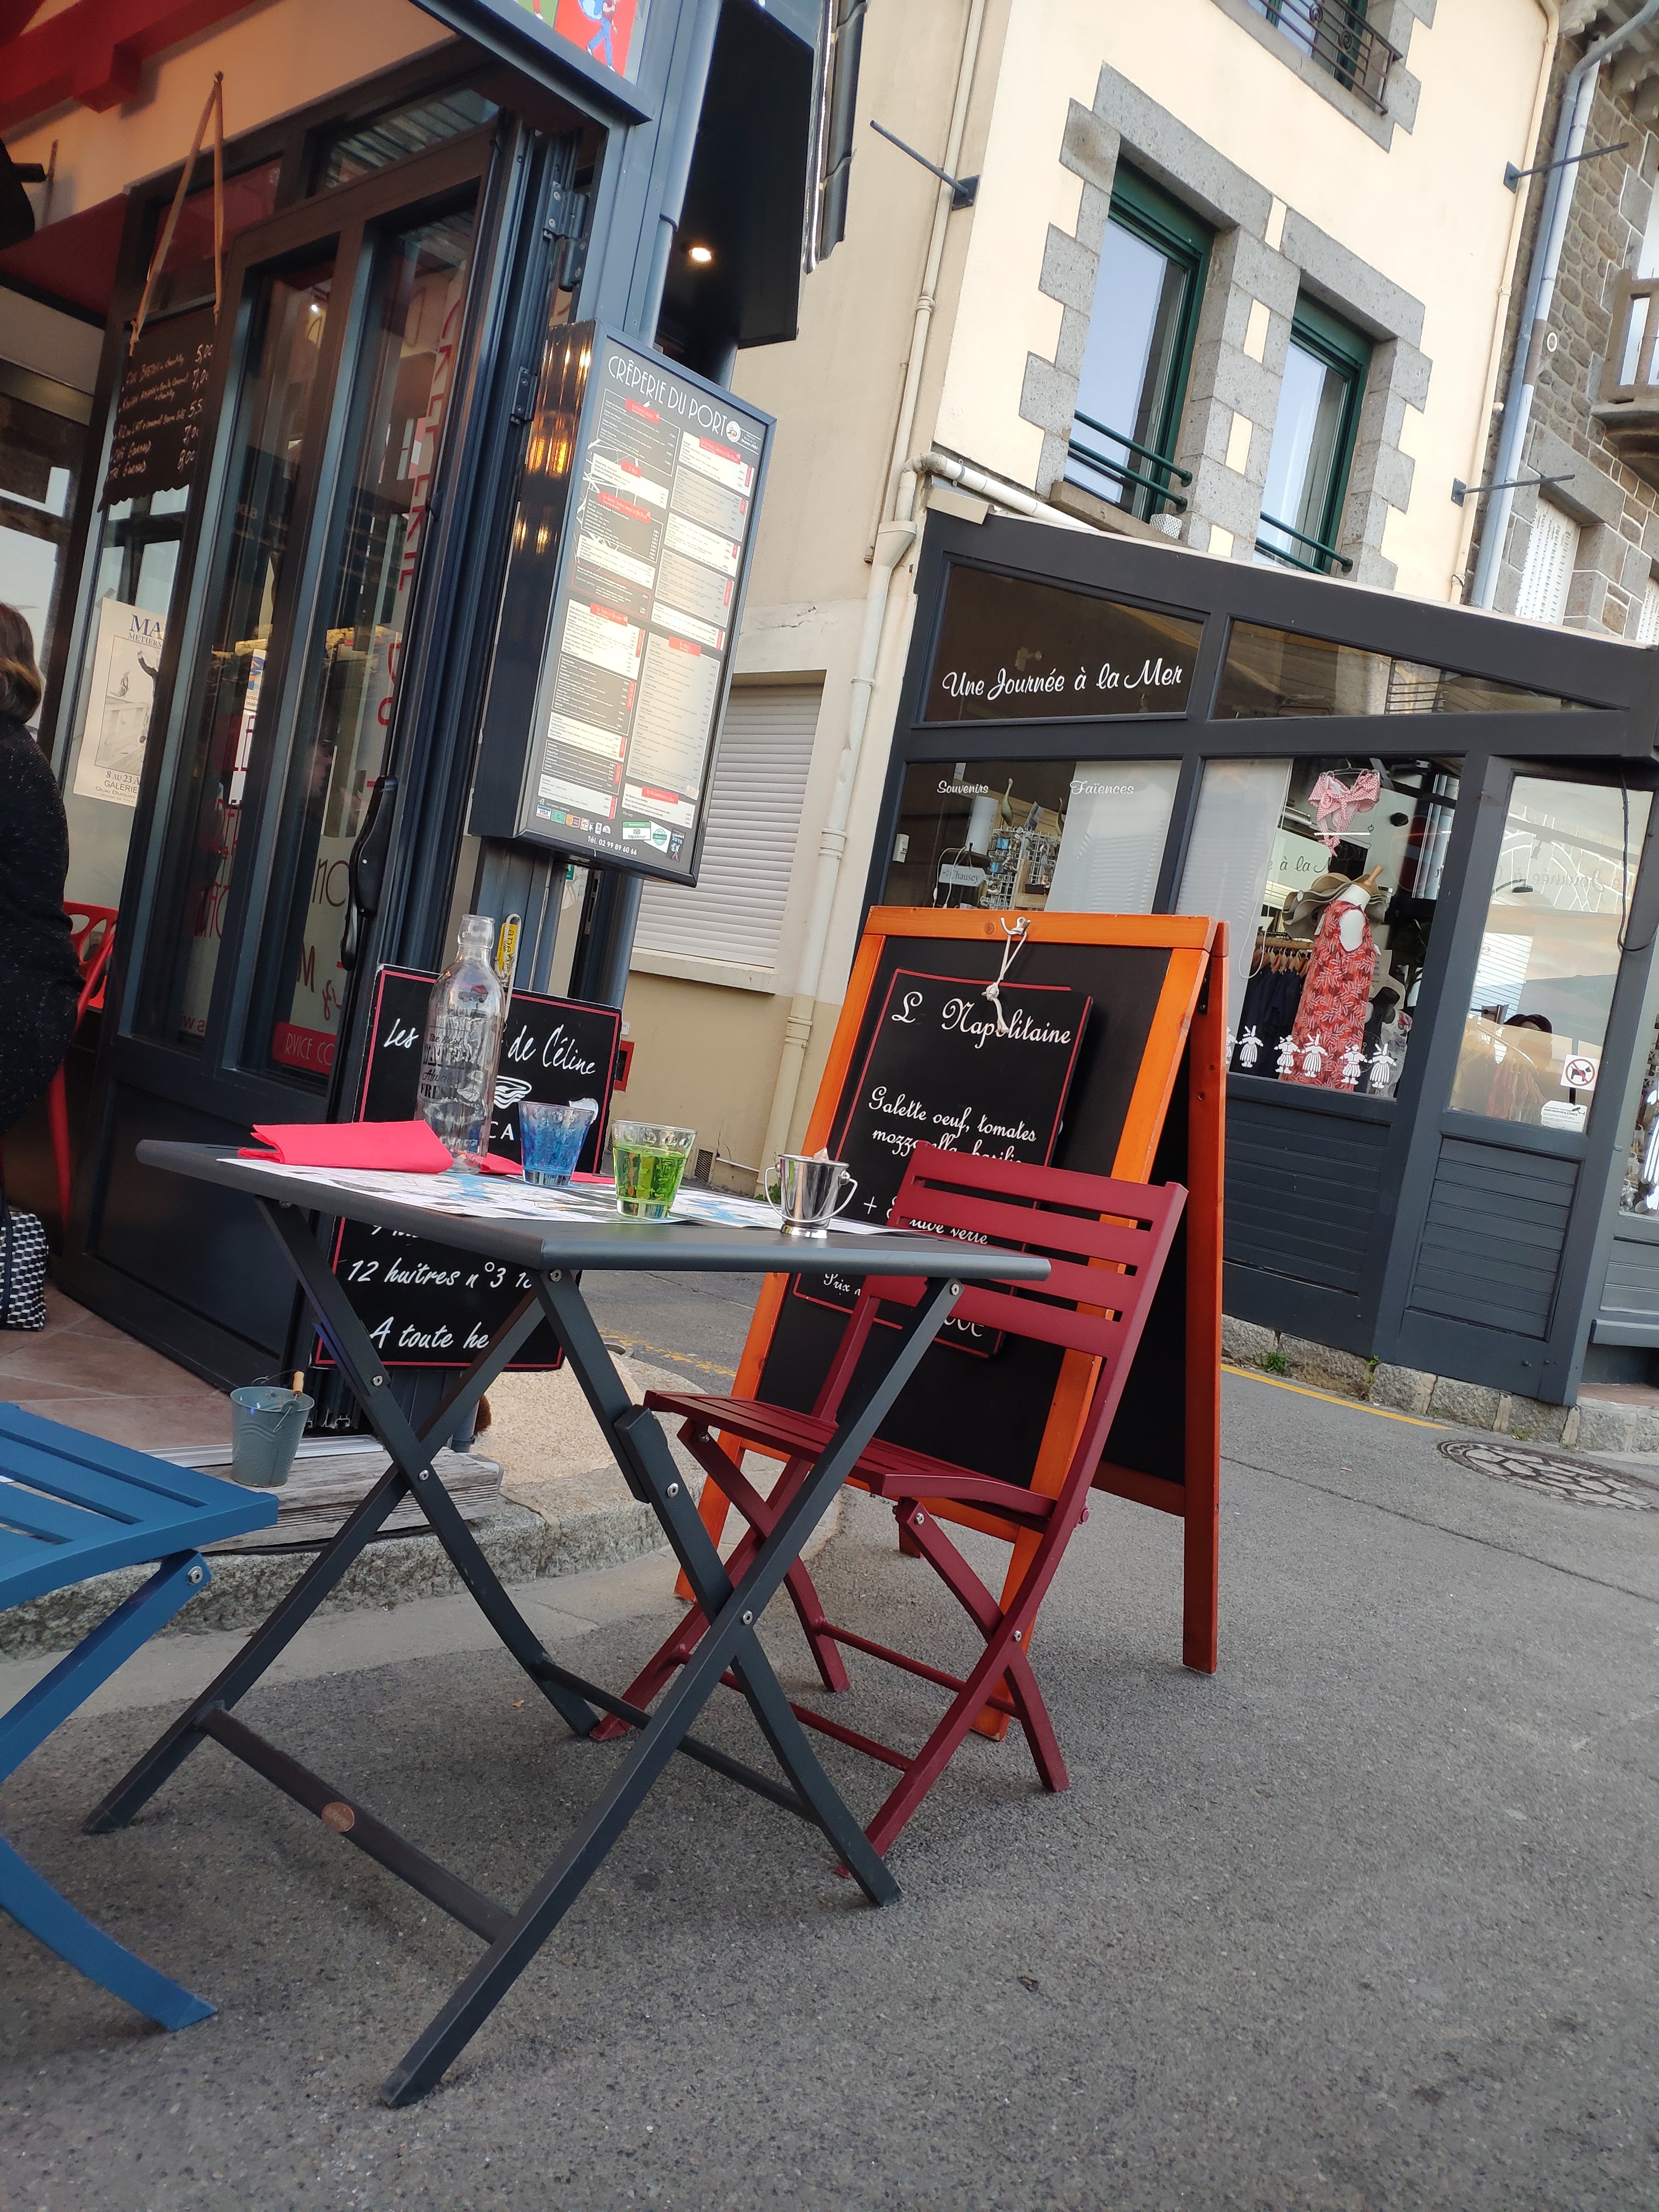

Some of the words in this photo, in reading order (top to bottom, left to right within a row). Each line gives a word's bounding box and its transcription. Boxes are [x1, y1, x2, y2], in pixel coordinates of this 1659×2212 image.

[608, 356, 667, 405] CRÊPERIE
[668, 386, 686, 415] DU
[689, 397, 727, 437] PORT
[128, 632, 162, 648] METIERS
[942, 672, 985, 697] Une
[987, 668, 1065, 701] Journée
[1074, 667, 1087, 691] à
[1096, 663, 1120, 690] la
[1124, 658, 1183, 689] Mer
[104, 780, 138, 794] GALERIE
[123, 775, 132, 783] 23
[936, 780, 989, 794] Souvenirs
[1069, 780, 1134, 795] Faïences
[587, 836, 597, 844] Tél.
[1280, 856, 1288, 871] à
[1295, 856, 1311, 872] la
[950, 870, 980, 884] Chausey
[383, 1018, 419, 1048] Les
[508, 1025, 536, 1062] de
[543, 1024, 596, 1075] Céline
[868, 1086, 927, 1121] Galette
[933, 1107, 972, 1138] oeuf,
[977, 1114, 1037, 1142] tomates
[347, 1260, 379, 1282] 12
[369, 1316, 394, 1348] A
[398, 1324, 454, 1348] toute
